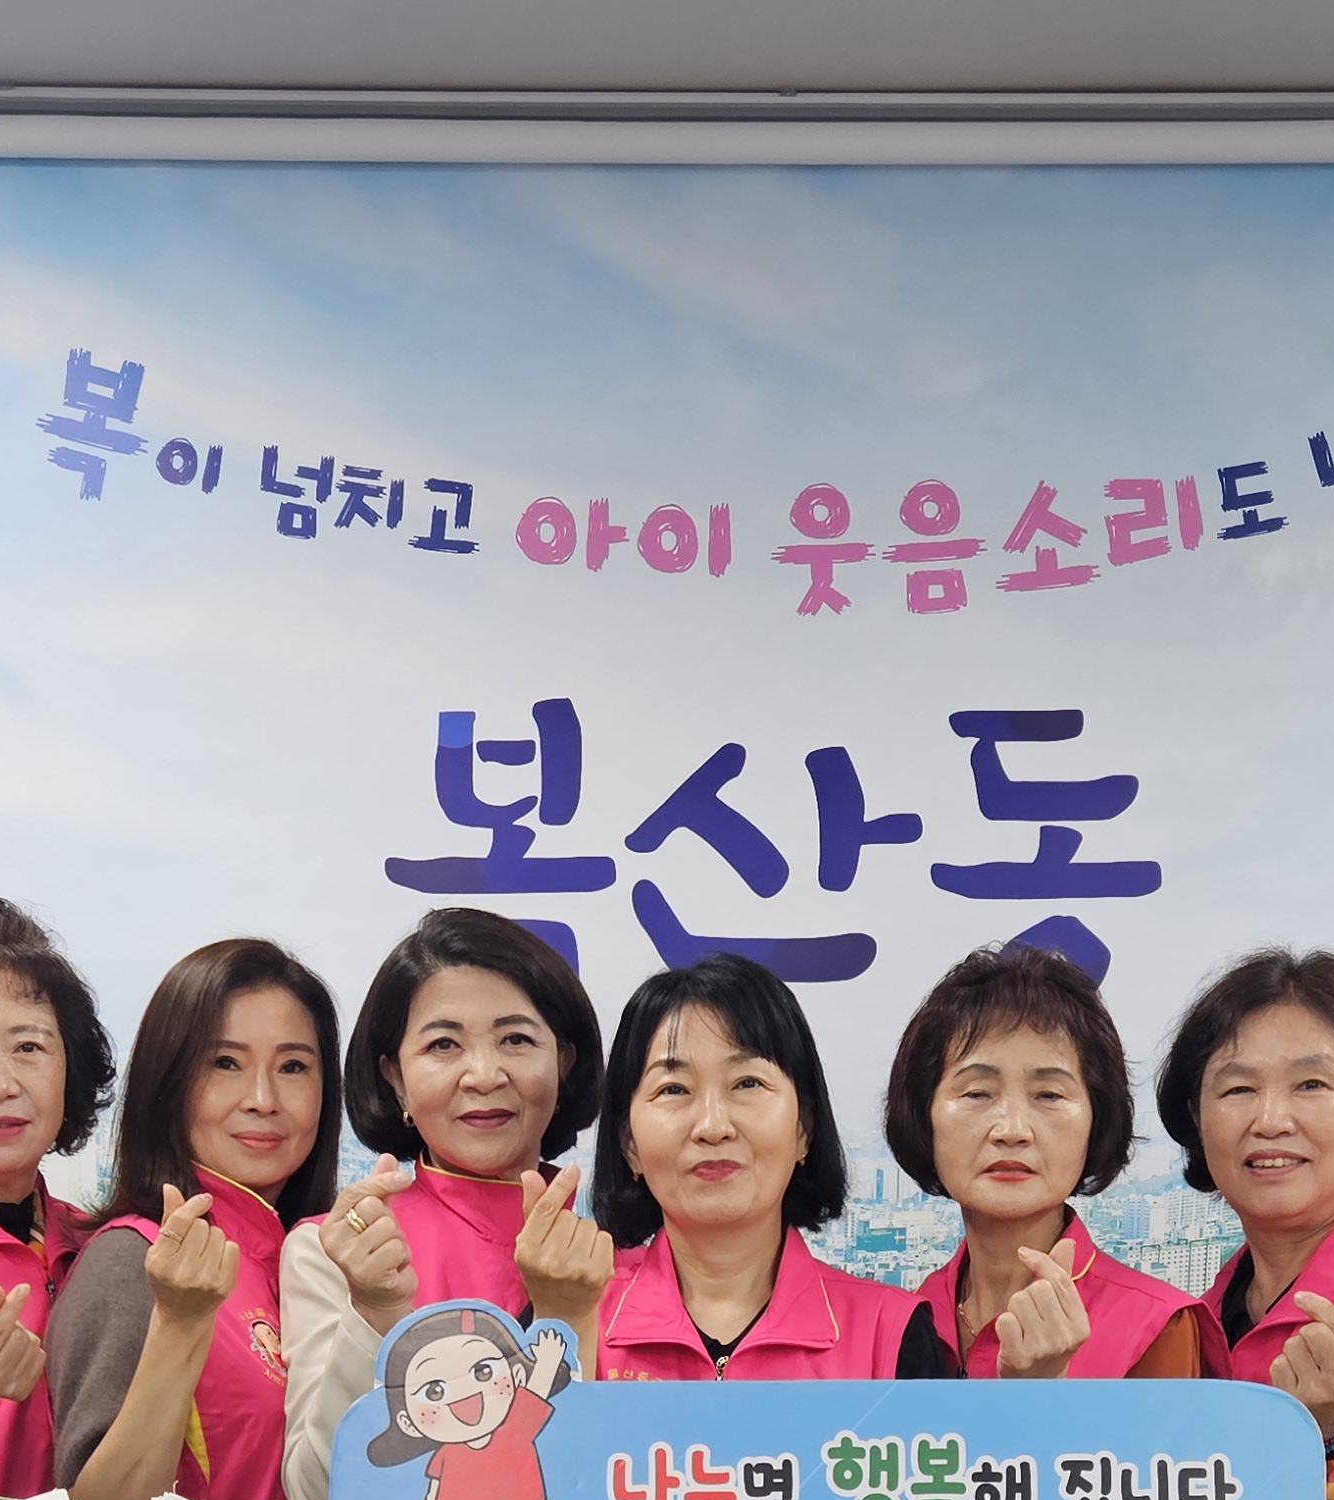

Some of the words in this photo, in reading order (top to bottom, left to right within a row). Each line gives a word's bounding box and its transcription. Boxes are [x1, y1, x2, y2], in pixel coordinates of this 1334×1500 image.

[35, 347, 223, 501] 복이
[260, 443, 480, 554] 넘치고
[516, 495, 732, 578] 아이
[771, 460, 1287, 616] 웃음소리도
[385, 698, 1162, 987] 복산동
